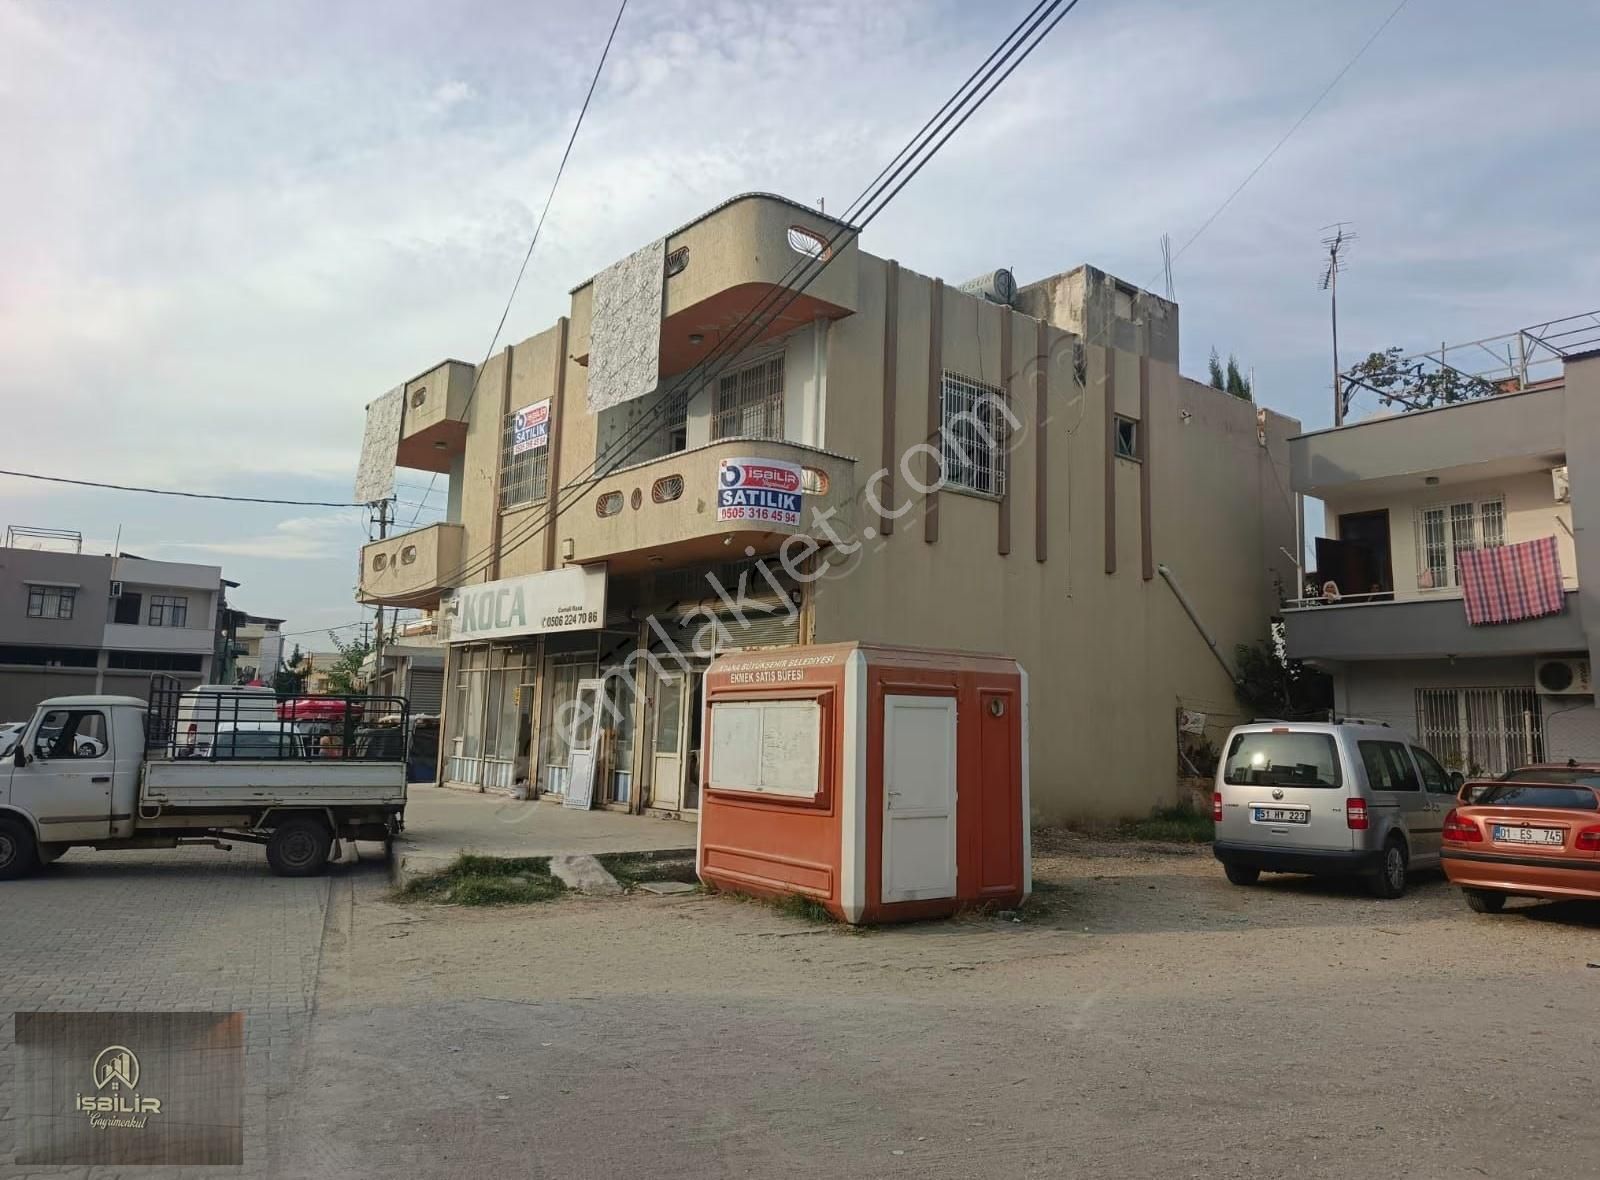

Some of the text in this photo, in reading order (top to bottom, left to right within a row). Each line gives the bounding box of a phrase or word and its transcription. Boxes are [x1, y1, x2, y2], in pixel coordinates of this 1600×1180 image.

[516, 423, 546, 443] SATILIK
[722, 490, 796, 510] SATILIK
[721, 507, 796, 523] 0505 316 45 94
[462, 585, 527, 633] KOCA
[546, 611, 598, 627] 0506 224 70 86
[730, 672, 754, 684] EKMEK
[1289, 812, 1305, 821] 223
[1500, 827, 1561, 842] 01 ES 745
